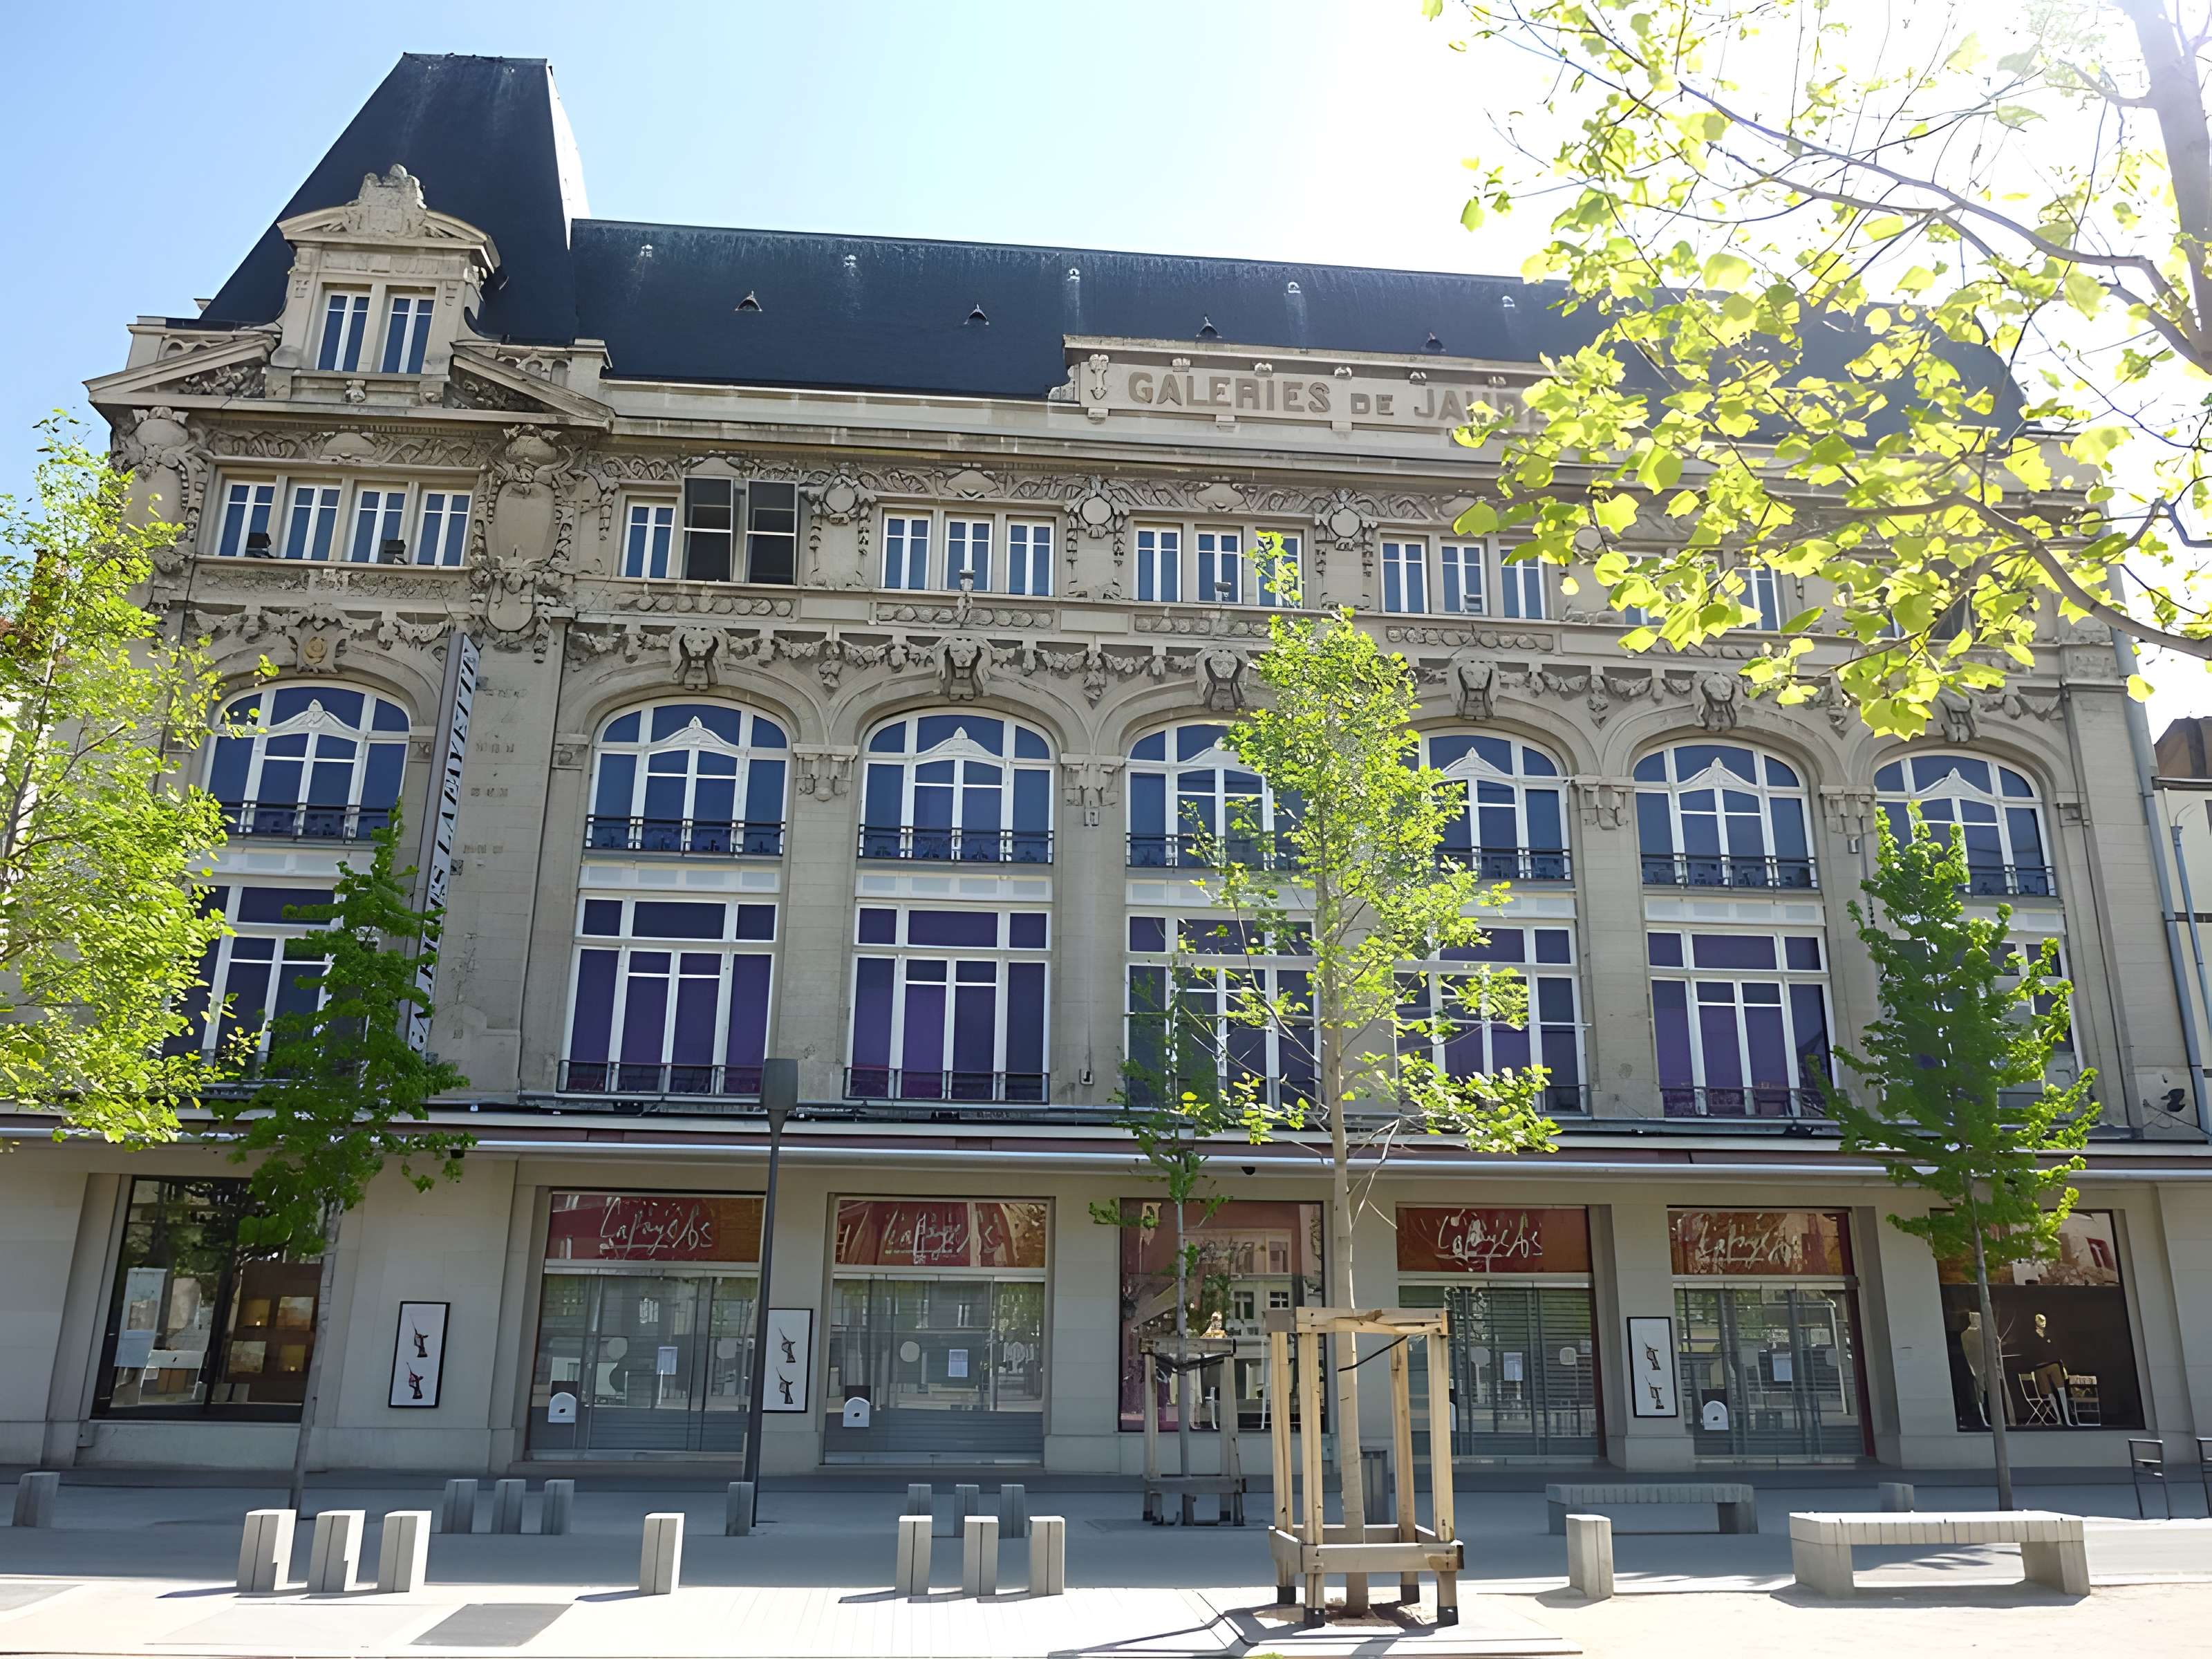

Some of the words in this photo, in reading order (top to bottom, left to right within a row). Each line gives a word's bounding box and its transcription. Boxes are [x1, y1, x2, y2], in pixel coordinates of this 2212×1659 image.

[1127, 371, 1331, 413] GALERIES
[1350, 392, 1394, 415] DE
[1414, 388, 1549, 427] JAUD
